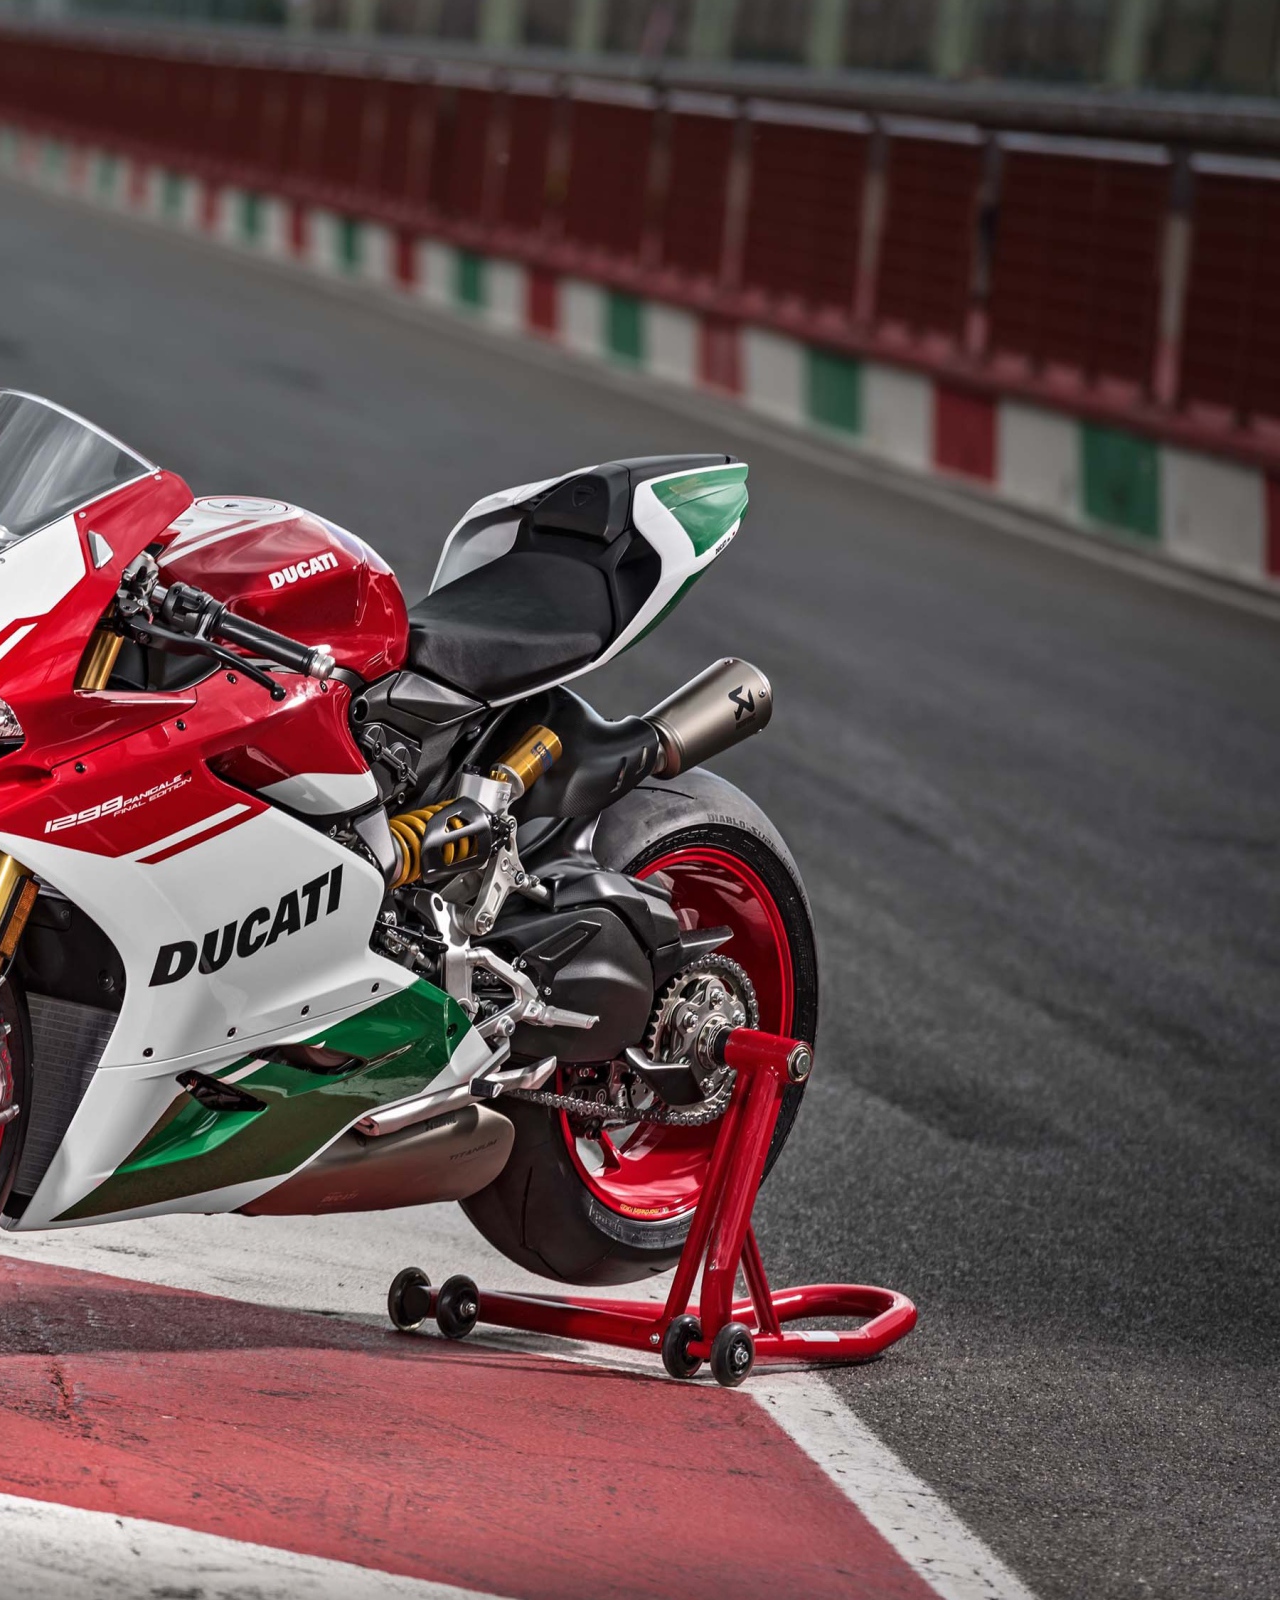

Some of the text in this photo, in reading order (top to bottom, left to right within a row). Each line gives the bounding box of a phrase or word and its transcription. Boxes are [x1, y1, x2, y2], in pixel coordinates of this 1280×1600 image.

[268, 552, 339, 590] DUCATI
[44, 795, 123, 834] 1299
[124, 774, 182, 807] PANIGALE
[114, 776, 192, 817] FINAL EDITION
[706, 811, 746, 829] DIABLO
[148, 863, 343, 987] DUCATI
[450, 1139, 498, 1160] TITANIUM
